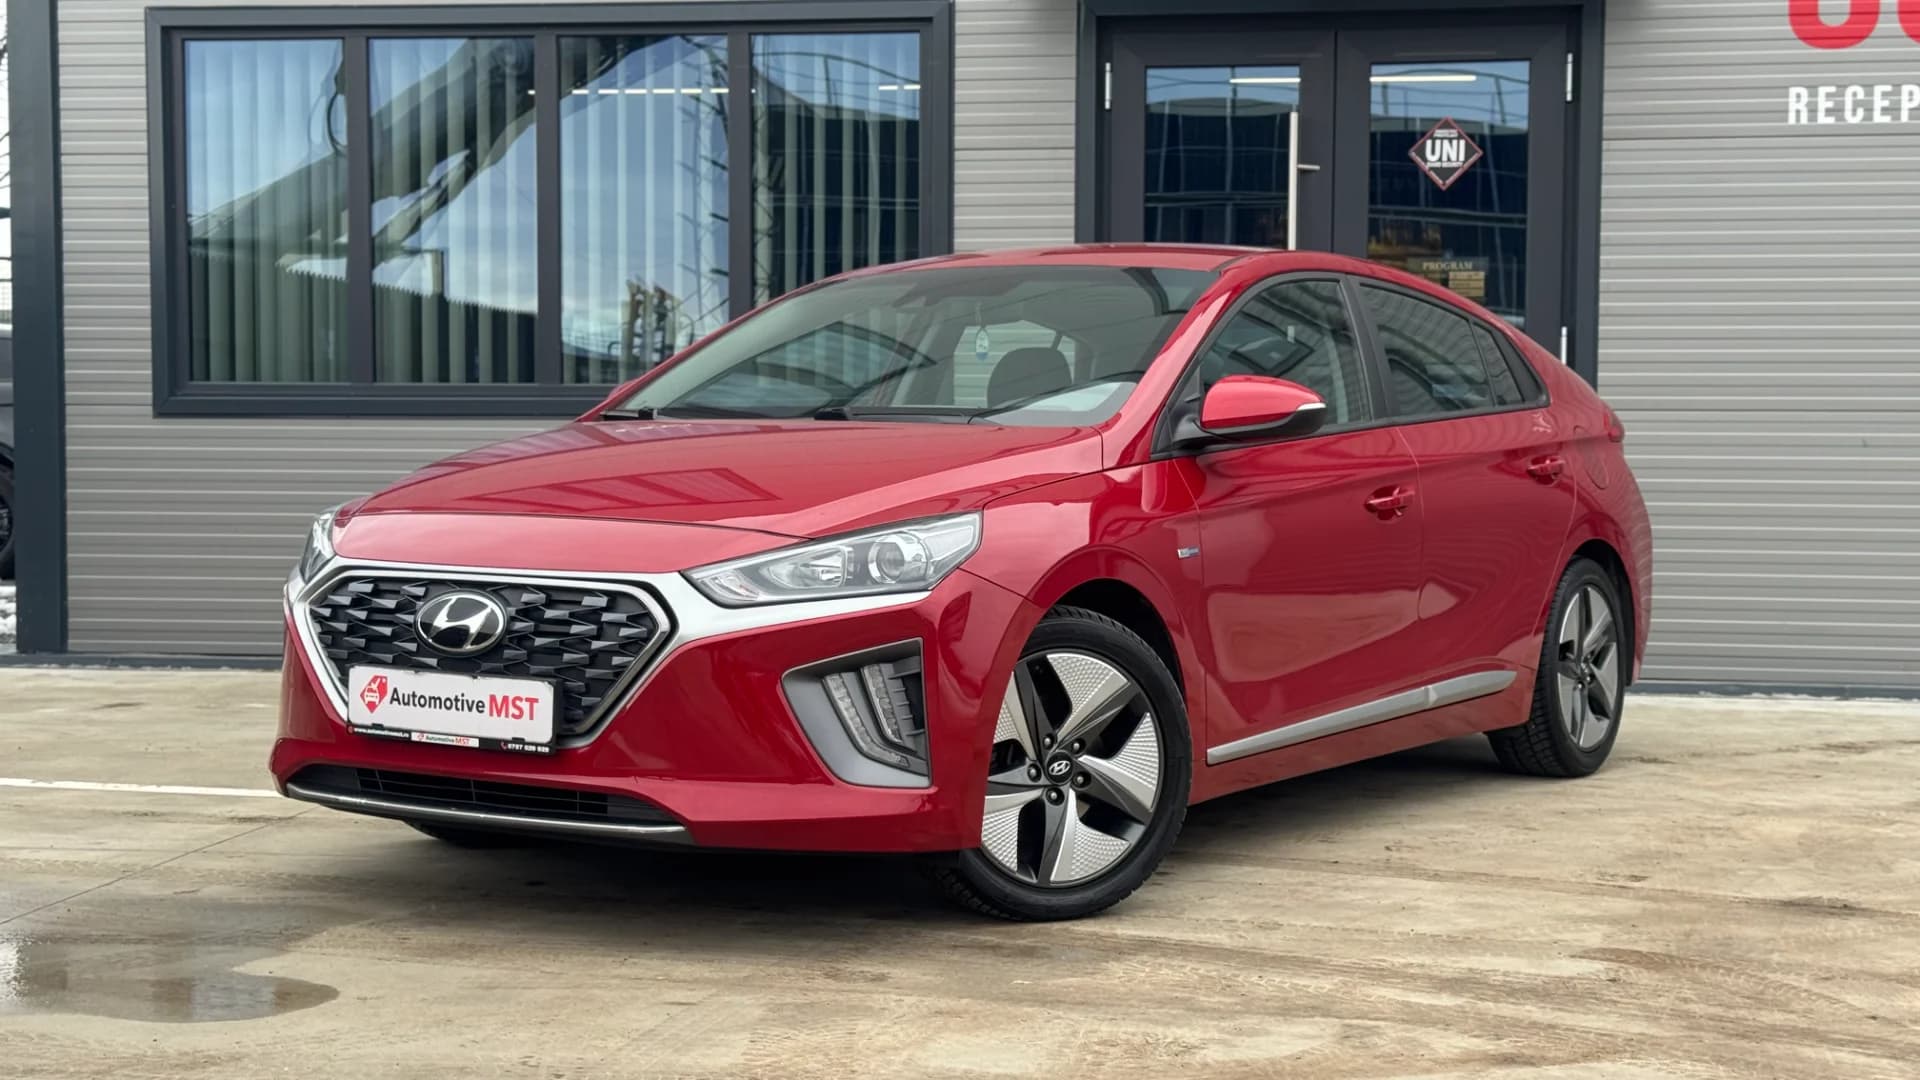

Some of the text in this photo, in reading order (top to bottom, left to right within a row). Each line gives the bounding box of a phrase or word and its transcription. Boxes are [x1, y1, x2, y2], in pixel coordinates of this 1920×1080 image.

[1788, 84, 1920, 125] RECEP
[1425, 139, 1466, 162] UNI
[1423, 261, 1473, 271] PROGRAM
[389, 687, 539, 720] Automotive MST
